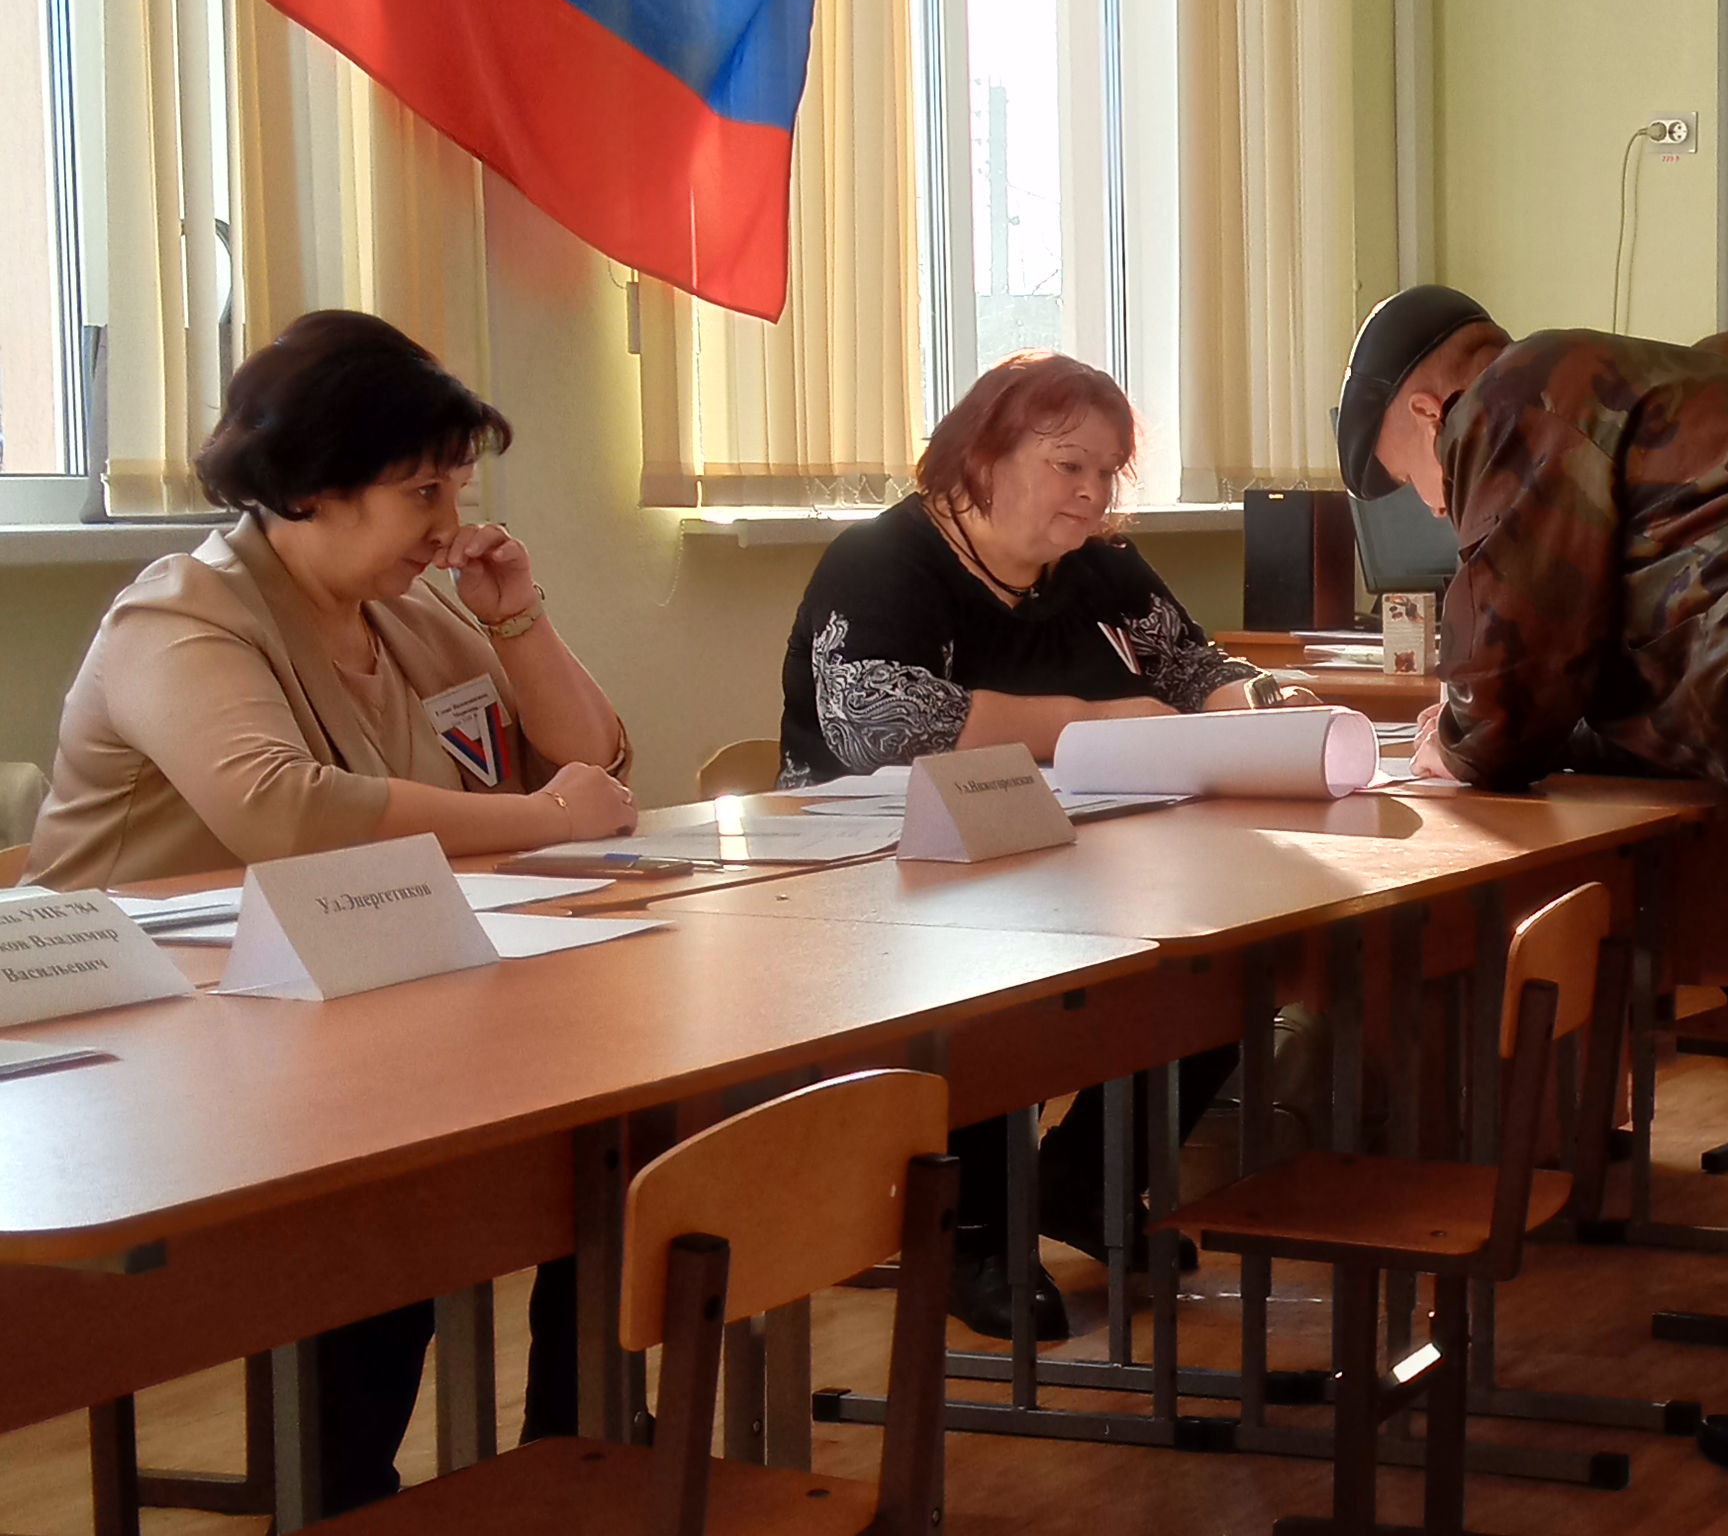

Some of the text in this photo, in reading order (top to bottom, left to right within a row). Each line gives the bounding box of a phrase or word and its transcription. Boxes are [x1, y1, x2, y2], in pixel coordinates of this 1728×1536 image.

[20, 905, 68, 922] УИК
[65, 901, 99, 915] 784
[28, 928, 119, 949] Владимир
[1, 958, 109, 983] Васильевич
